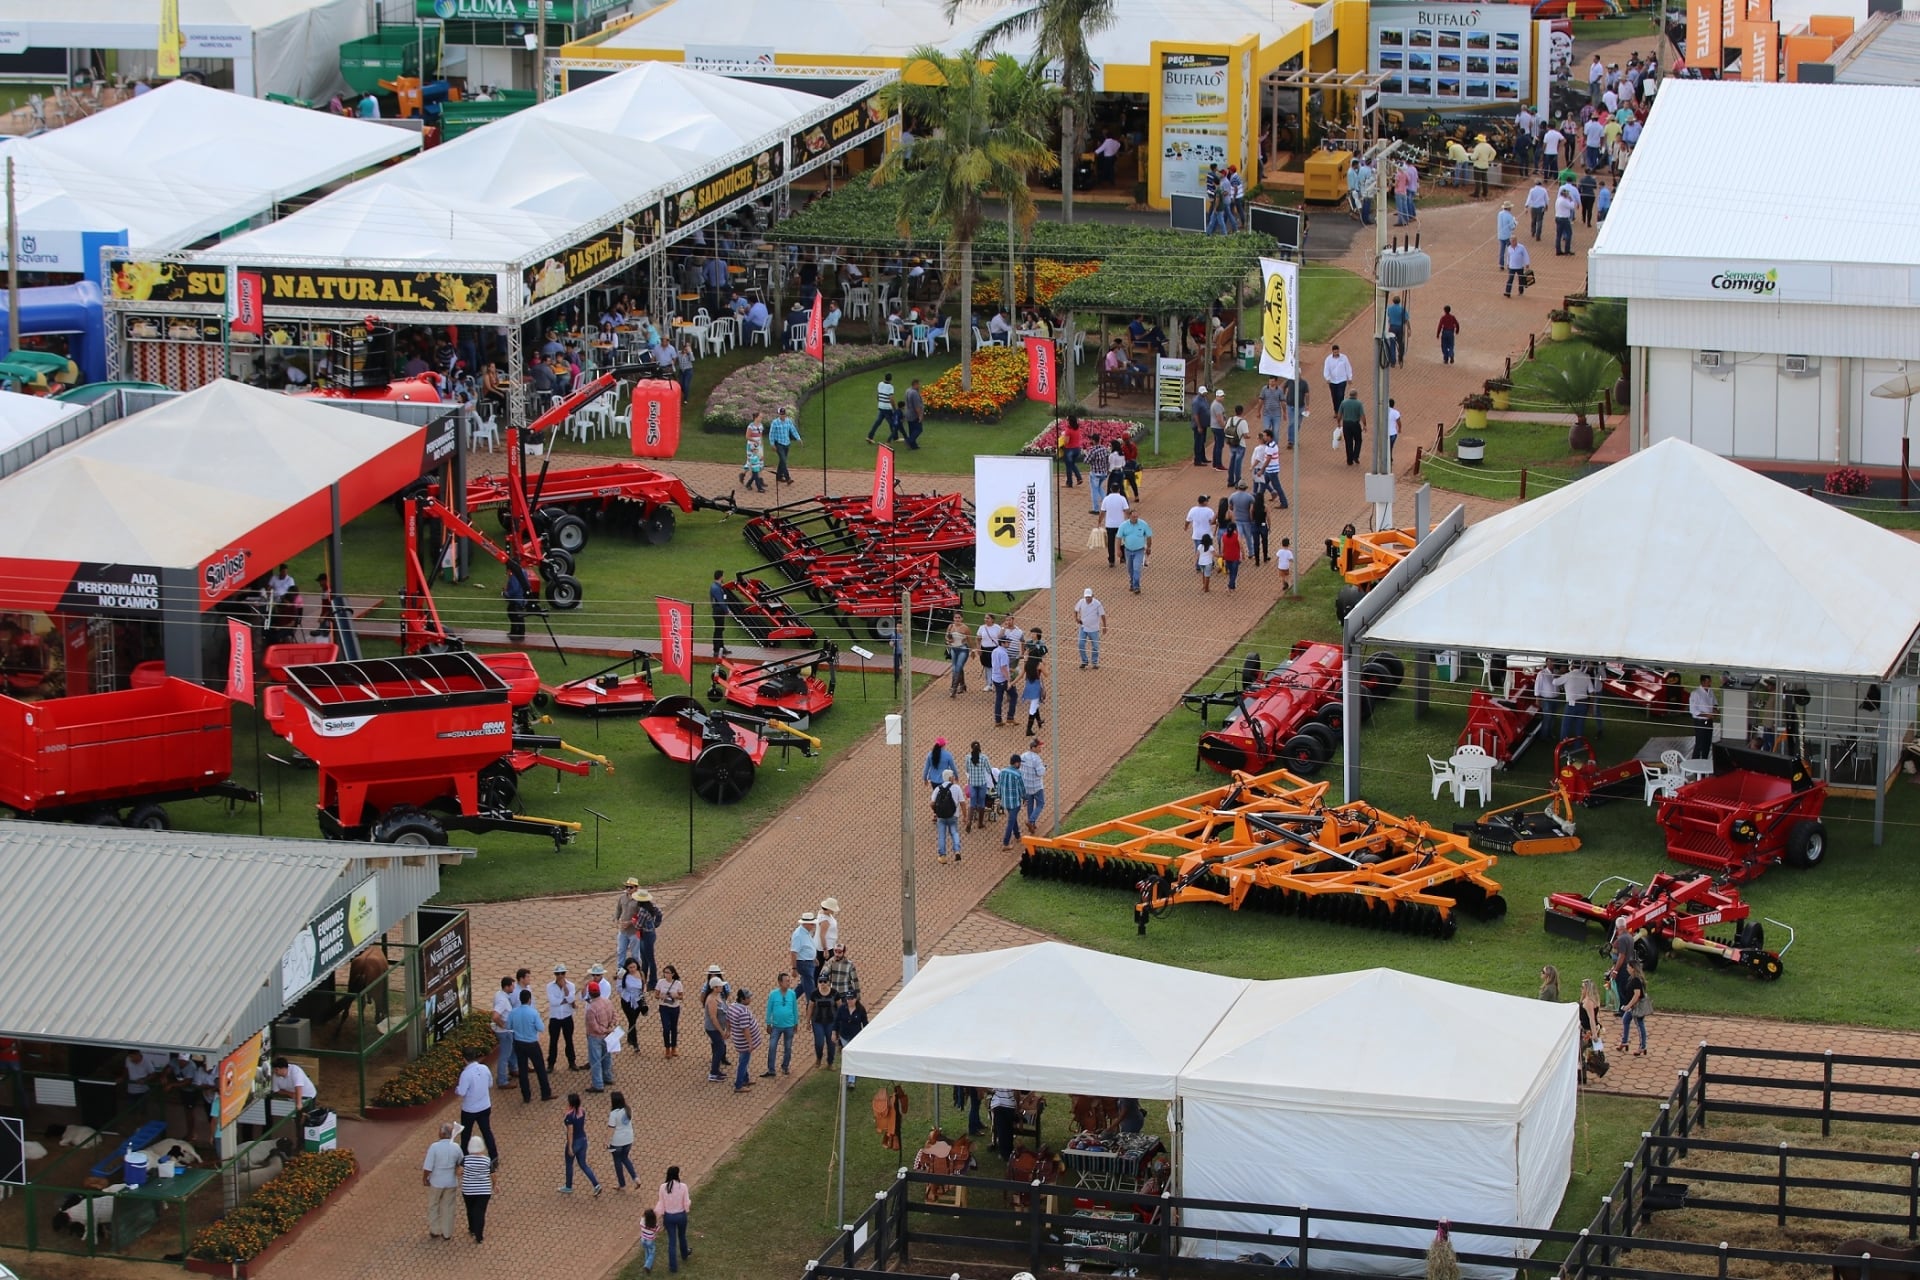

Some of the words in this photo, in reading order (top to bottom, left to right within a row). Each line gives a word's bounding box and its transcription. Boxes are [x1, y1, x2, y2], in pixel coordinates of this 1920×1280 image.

[457, 0, 517, 13] LUMA
[1418, 11, 1477, 27] BUFFALO
[1166, 71, 1221, 86] BUFFALO
[832, 109, 860, 141] CREPE
[1, 252, 58, 264] Hsqvarna
[569, 237, 613, 277] PASTEL
[1724, 270, 1766, 280] Sementes
[272, 274, 419, 303] NATURAL
[1711, 274, 1776, 294] Comigo
[1027, 482, 1036, 521] IZABEL
[1027, 527, 1036, 563] SANTA
[131, 573, 158, 585] ALTA
[77, 581, 159, 598] PERFORMANCE
[99, 595, 116, 607] NO
[118, 597, 159, 609] CAMPO
[482, 721, 505, 730] GRAN
[318, 907, 345, 937] EQUINOS
[1698, 916, 1705, 925] EL
[1705, 913, 1722, 924] 5000
[319, 923, 344, 952] MUARES
[320, 939, 344, 966] OVINOS
